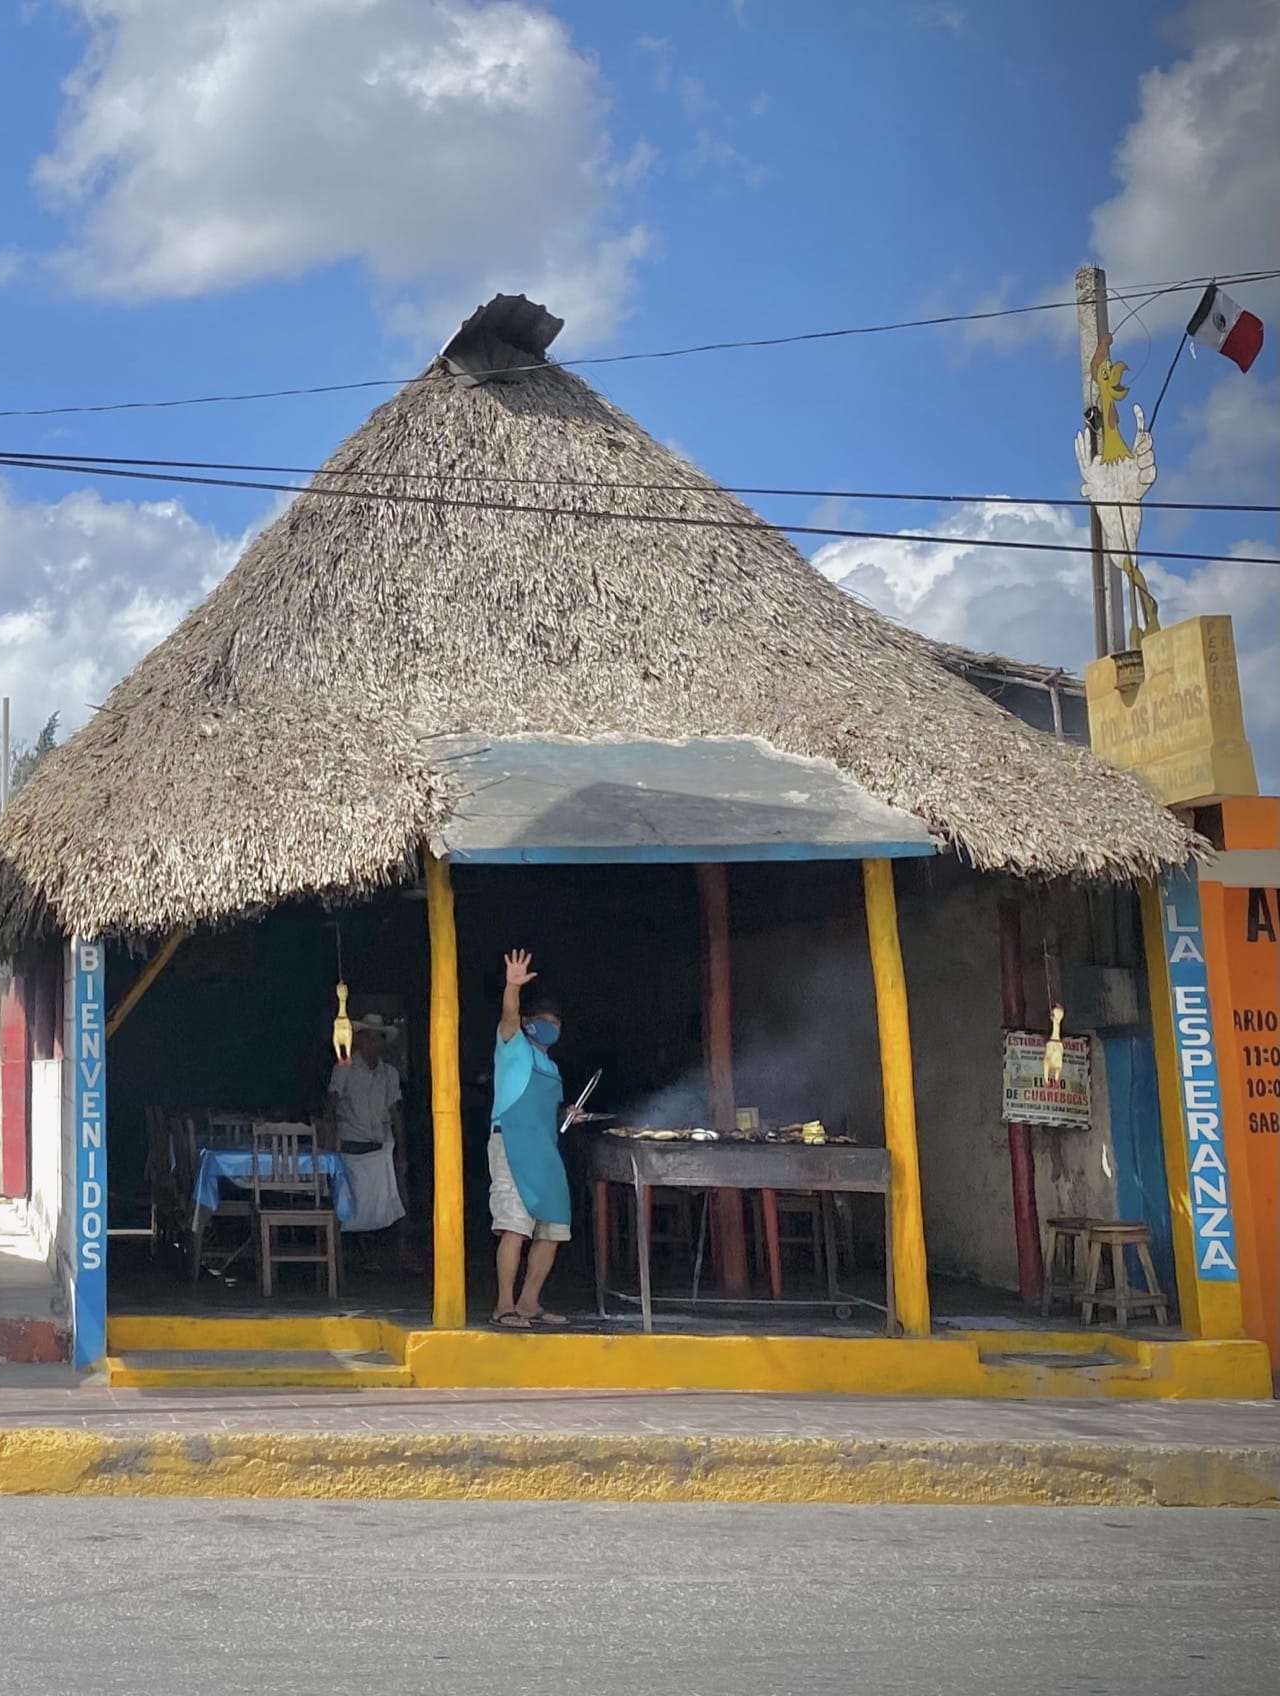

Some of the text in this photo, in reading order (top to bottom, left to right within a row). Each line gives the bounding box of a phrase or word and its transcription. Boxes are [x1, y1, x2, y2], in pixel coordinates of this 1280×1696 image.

[80, 946, 102, 1270] BIENVENIDOS
[1006, 1088, 1018, 1100] DE
[1166, 904, 1236, 1271] LA ESPERANZA
